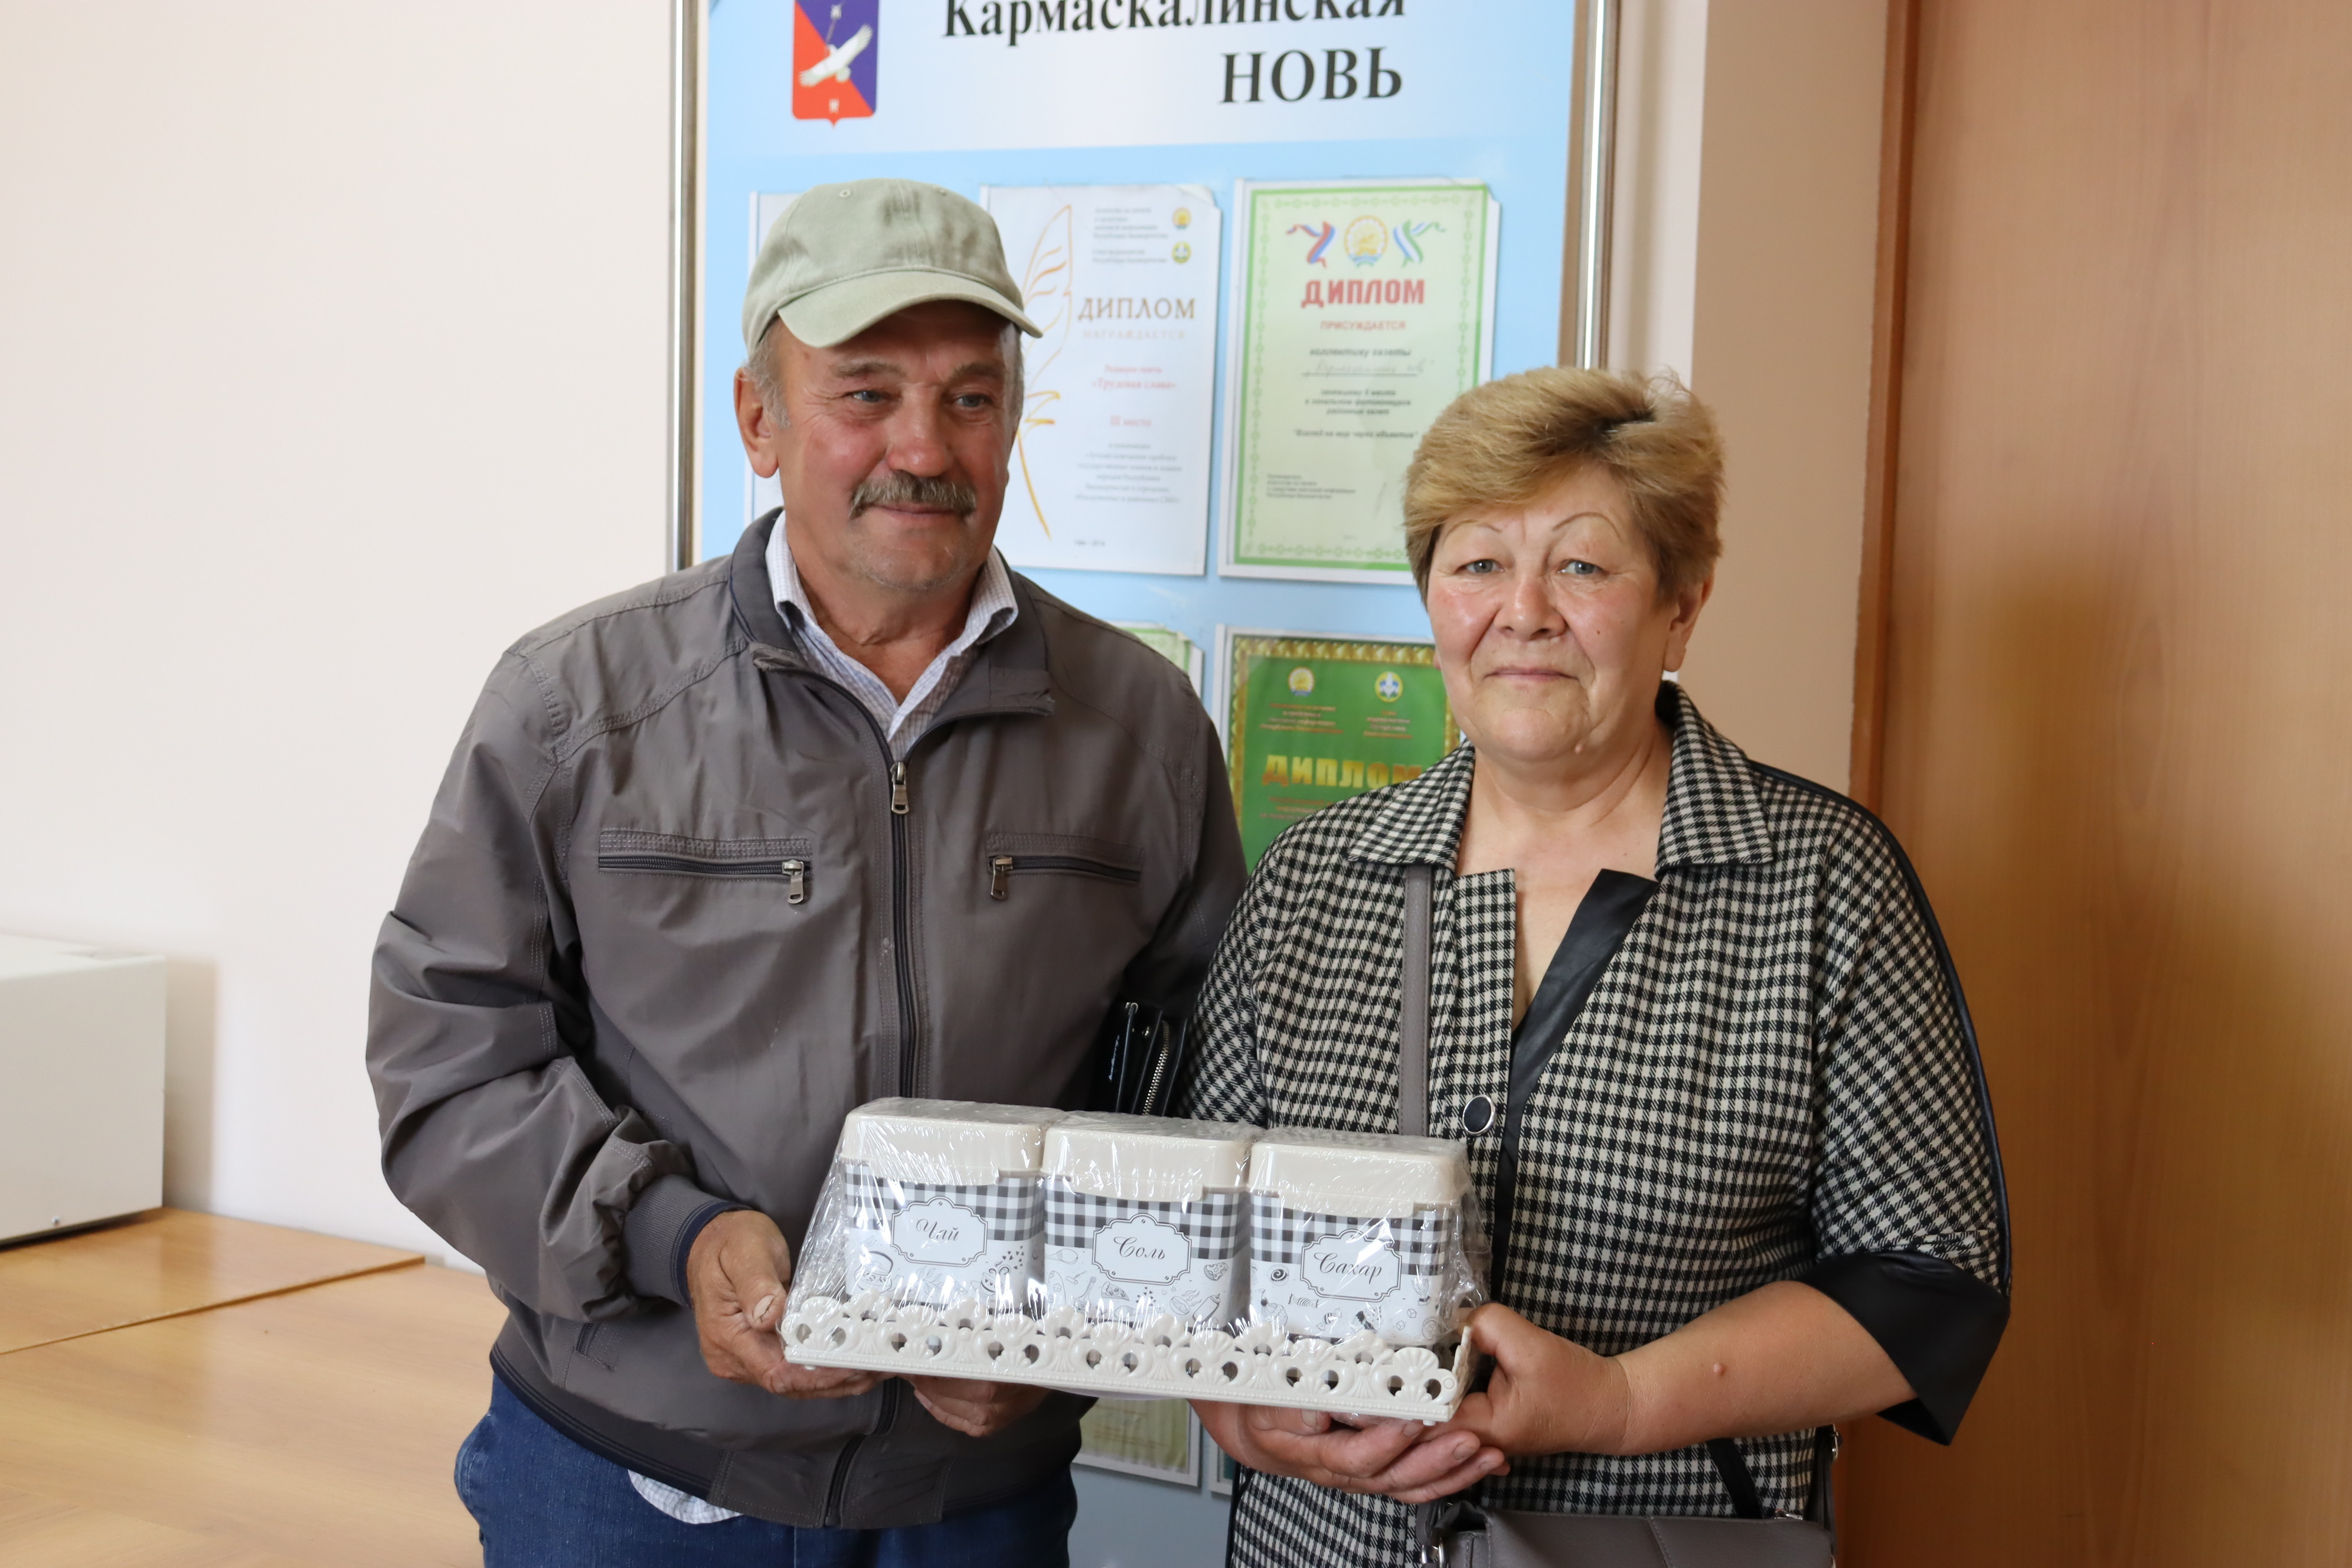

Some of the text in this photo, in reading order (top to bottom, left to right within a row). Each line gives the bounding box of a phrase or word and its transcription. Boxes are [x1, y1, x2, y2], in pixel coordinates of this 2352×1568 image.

[1219, 46, 1402, 103] НОВЬ
[1301, 279, 1425, 309] ДИПЛОМ
[1078, 298, 1195, 321] ДИПЛОМ
[1320, 320, 1406, 331] ПРИСУЖДАЕТСЯ
[916, 1219, 959, 1241] Чай
[1113, 1237, 1165, 1260] Соль
[1314, 1252, 1382, 1284] Сахар
